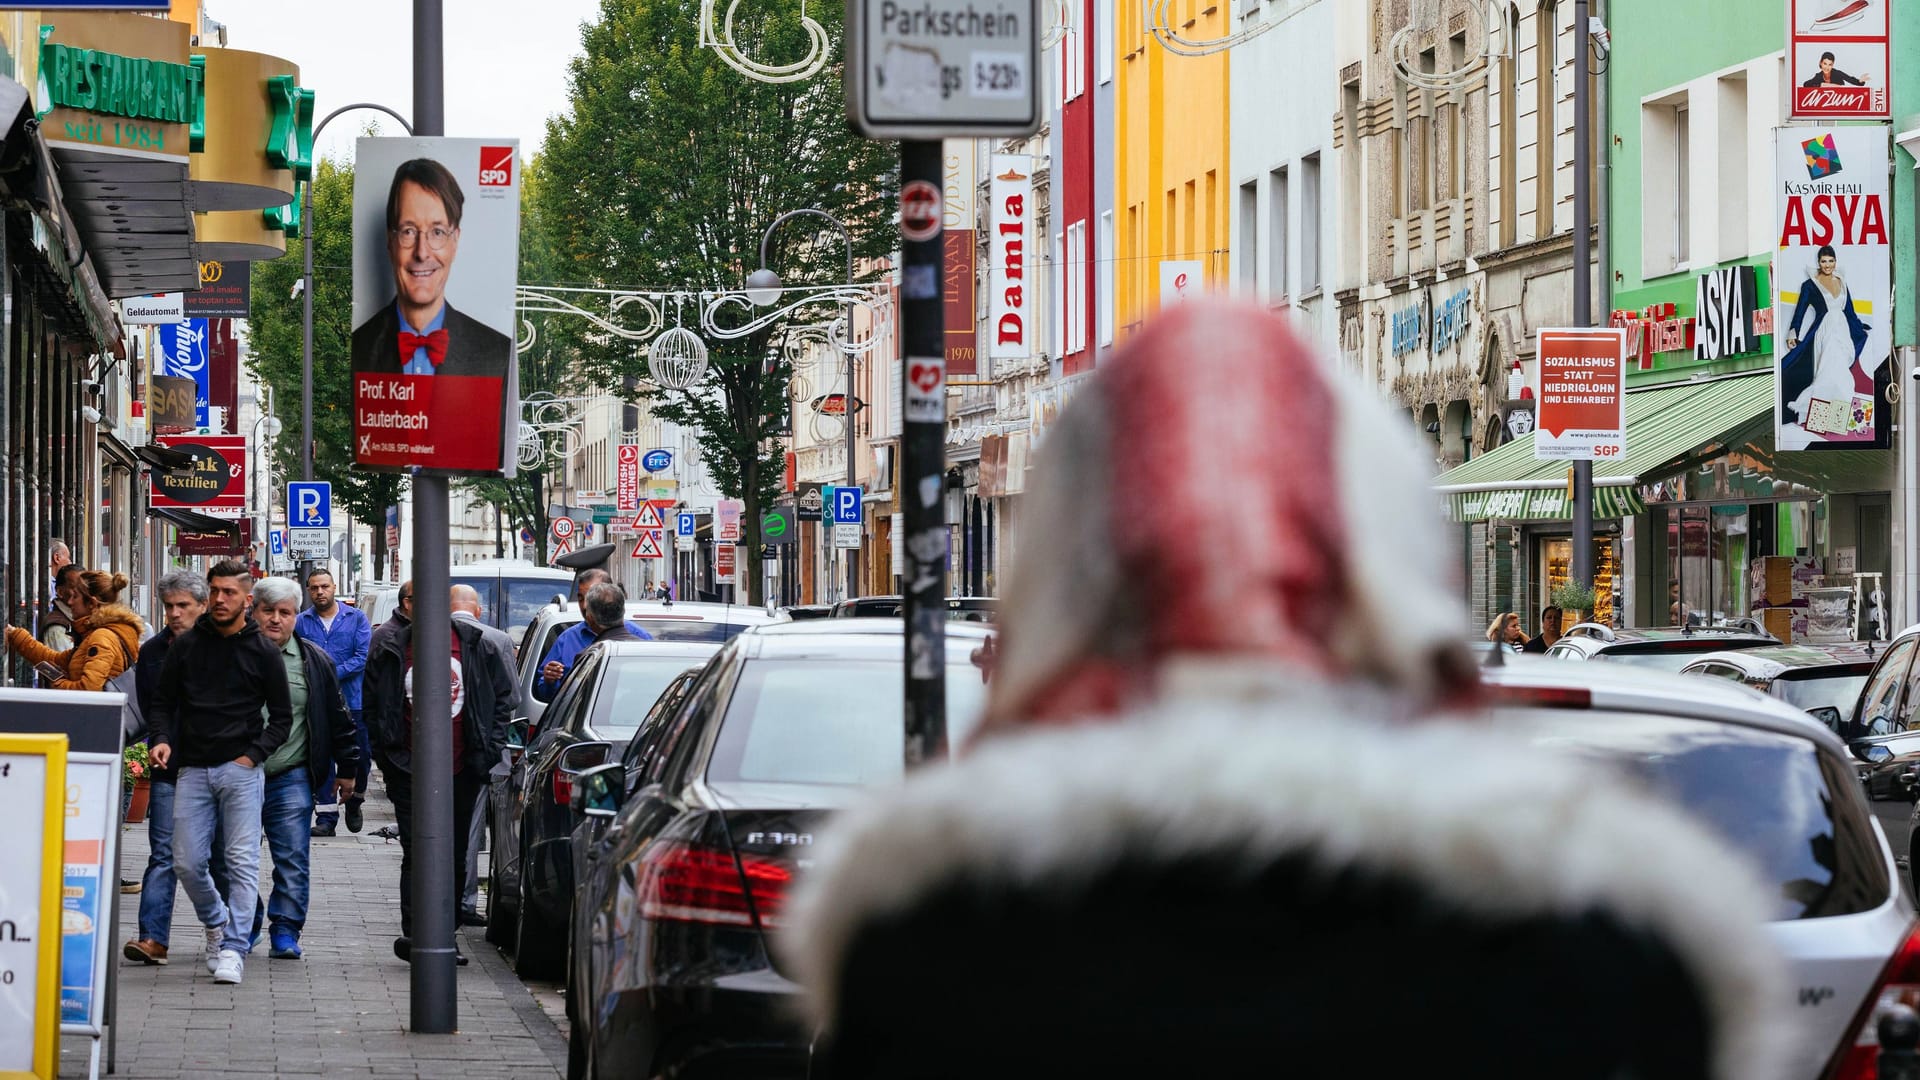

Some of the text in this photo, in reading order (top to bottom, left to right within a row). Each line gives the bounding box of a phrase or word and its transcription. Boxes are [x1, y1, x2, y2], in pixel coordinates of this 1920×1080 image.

[881, 1, 1018, 38] Parkschein
[54, 46, 204, 124] RESTAURANT
[1801, 88, 1865, 111] arzum
[64, 119, 165, 151] seit 1984
[480, 169, 508, 184] SPD
[1779, 194, 1889, 247] ASYA
[997, 192, 1024, 347] Damla
[127, 307, 180, 317] Geldautomat
[1693, 264, 1747, 361] ASYA
[951, 347, 976, 361] 1970
[1544, 357, 1616, 368] SOZIALISMUS
[1563, 371, 1594, 380] STATT
[359, 380, 415, 401] Prof. Karl
[1544, 383, 1616, 393] NIEDRIGLOHN
[1544, 395, 1615, 405] UND LEIHARBEIT
[359, 408, 429, 430] Lauterbach
[1593, 445, 1620, 457] SGP
[648, 458, 669, 467] EFES
[163, 475, 218, 489] Textilien
[619, 463, 629, 509] TURKISH
[628, 463, 637, 509] AIRLINES
[298, 488, 321, 522] P
[840, 491, 855, 519] P
[558, 523, 570, 533] 30
[681, 516, 691, 533] P
